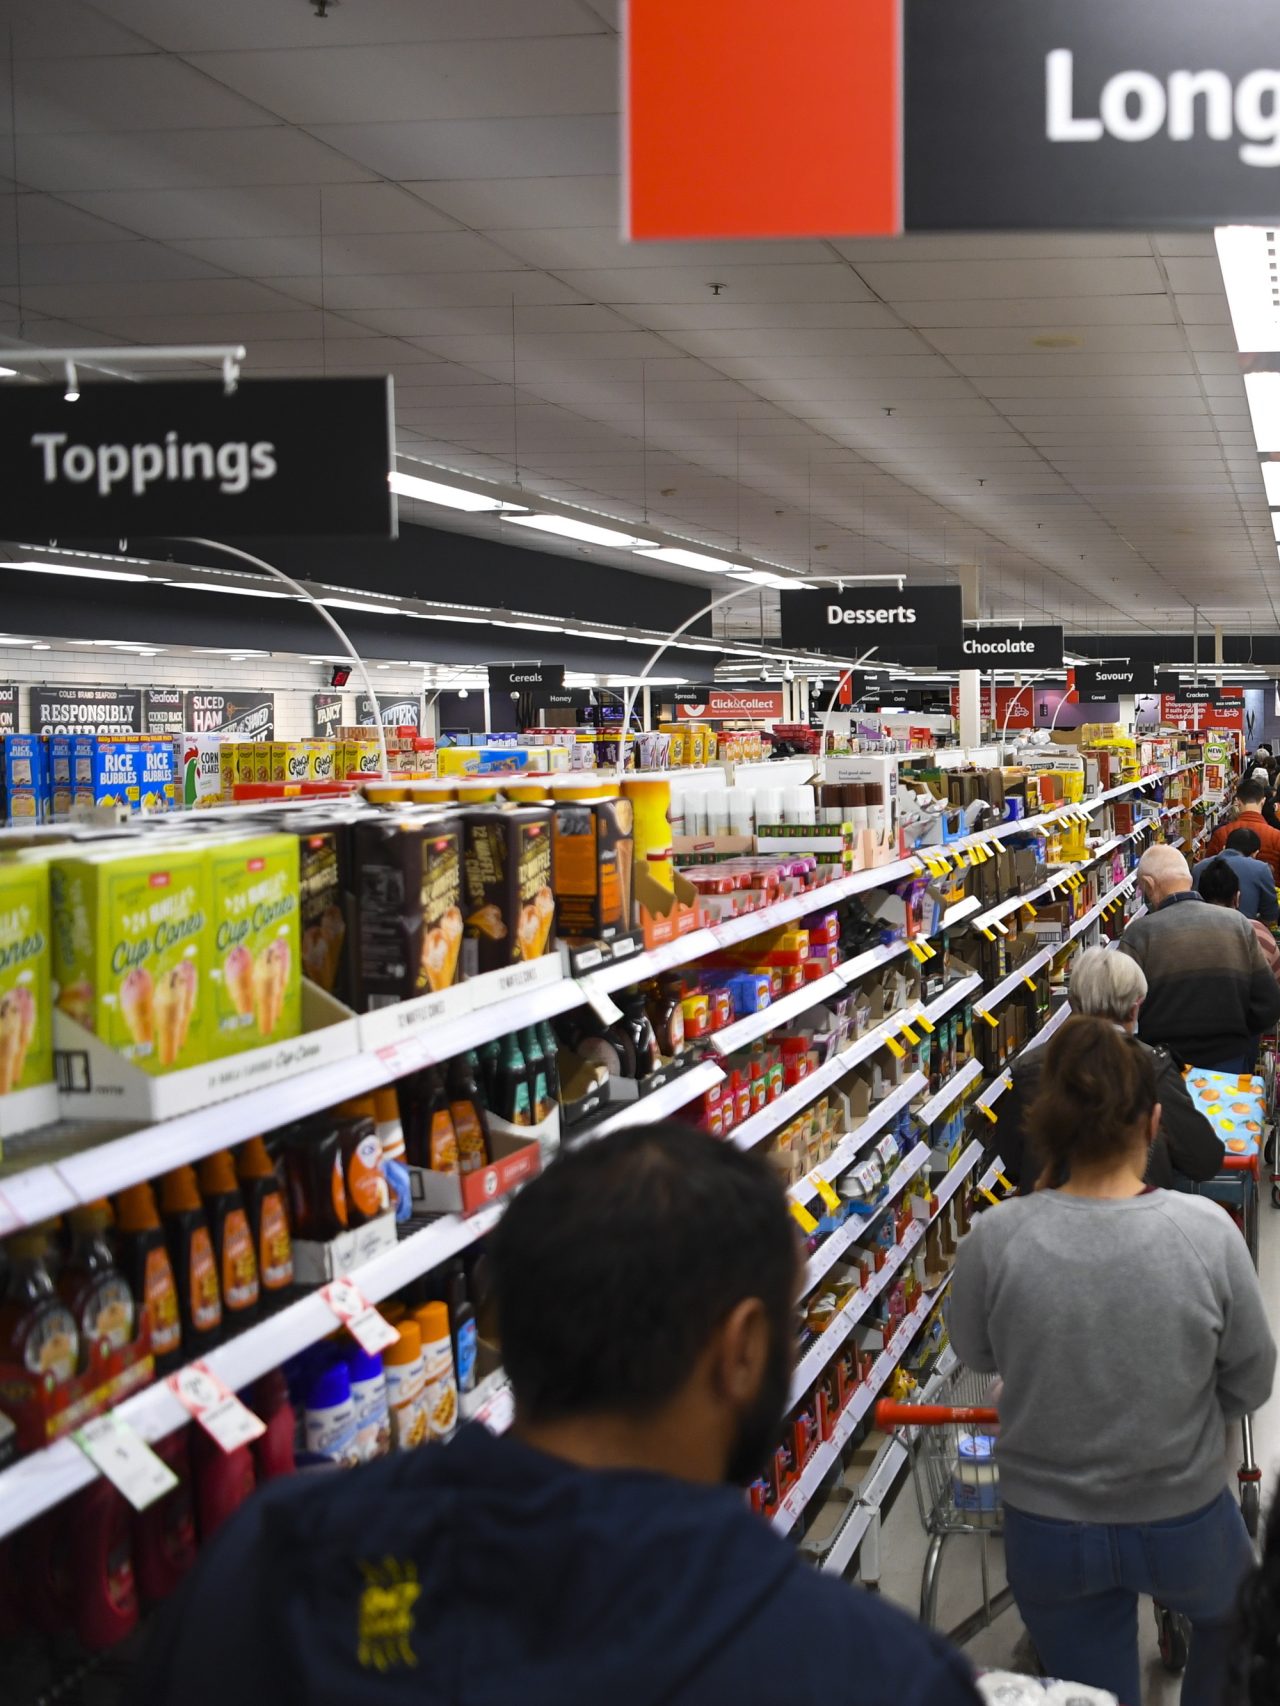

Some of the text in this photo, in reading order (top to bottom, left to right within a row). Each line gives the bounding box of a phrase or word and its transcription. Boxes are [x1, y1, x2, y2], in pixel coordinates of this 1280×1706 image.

[32, 431, 277, 495] Toppings
[827, 605, 917, 625] Desserts
[962, 637, 1036, 654] Chocolate
[509, 672, 543, 683] Cereals
[1095, 671, 1134, 682] Savoury
[59, 690, 76, 699] COLES
[150, 690, 180, 703] Seafood
[549, 695, 573, 706] Honey
[674, 692, 698, 701] Spreads
[193, 695, 225, 710] SLICED
[711, 698, 774, 710] Click&Collect
[40, 703, 135, 723] RESPONSIBLY
[317, 703, 342, 725] FANCY
[193, 710, 223, 732] HAM
[105, 754, 134, 771] RICE
[146, 752, 169, 770] RICE
[201, 752, 219, 763] CORN
[143, 770, 172, 782] BUBBLES
[201, 763, 219, 775] FLAKES
[100, 771, 137, 784] BUBBLES
[216, 893, 296, 951] Cup Cones
[112, 911, 205, 975] Cup Cones
